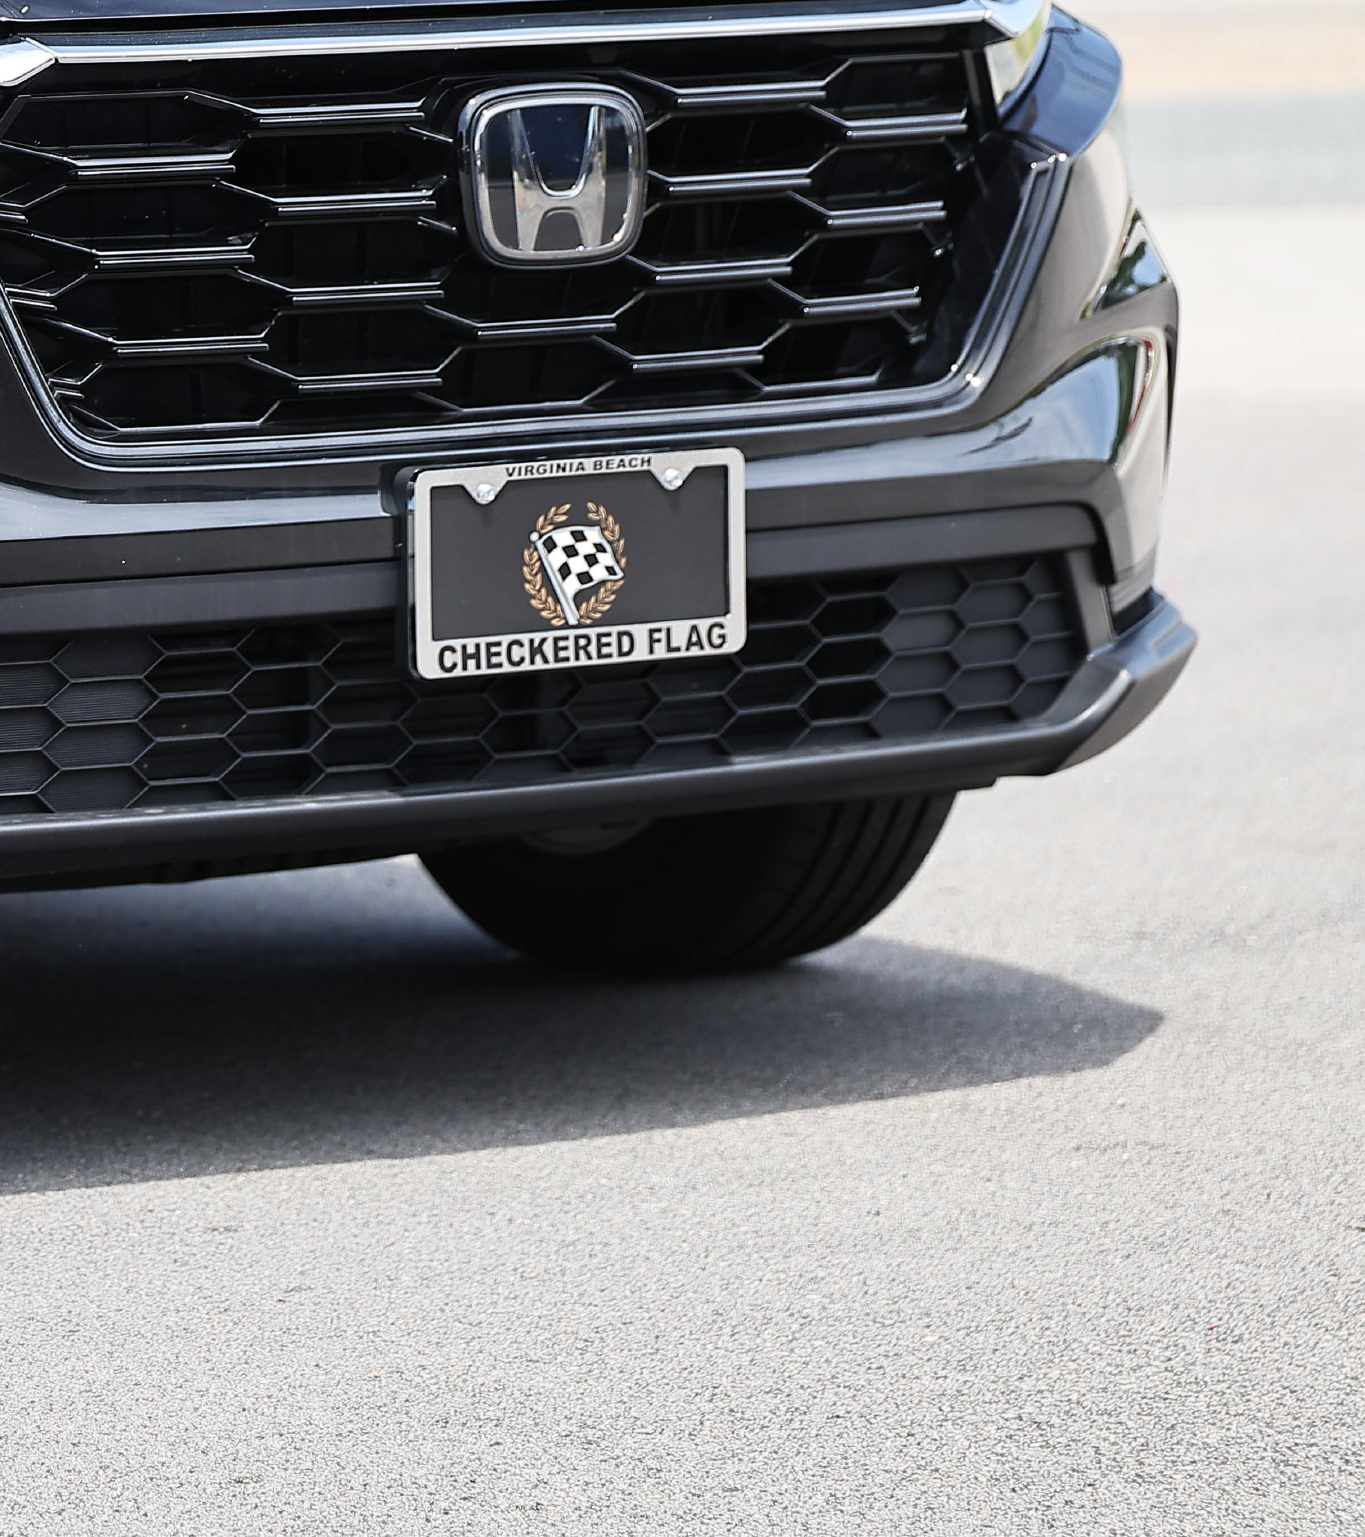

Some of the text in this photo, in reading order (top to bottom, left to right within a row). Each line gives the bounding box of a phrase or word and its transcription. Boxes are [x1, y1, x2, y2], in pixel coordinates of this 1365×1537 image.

[505, 456, 652, 478] VIRGINIA BEACH
[438, 623, 727, 673] CHECKERED FLAG
